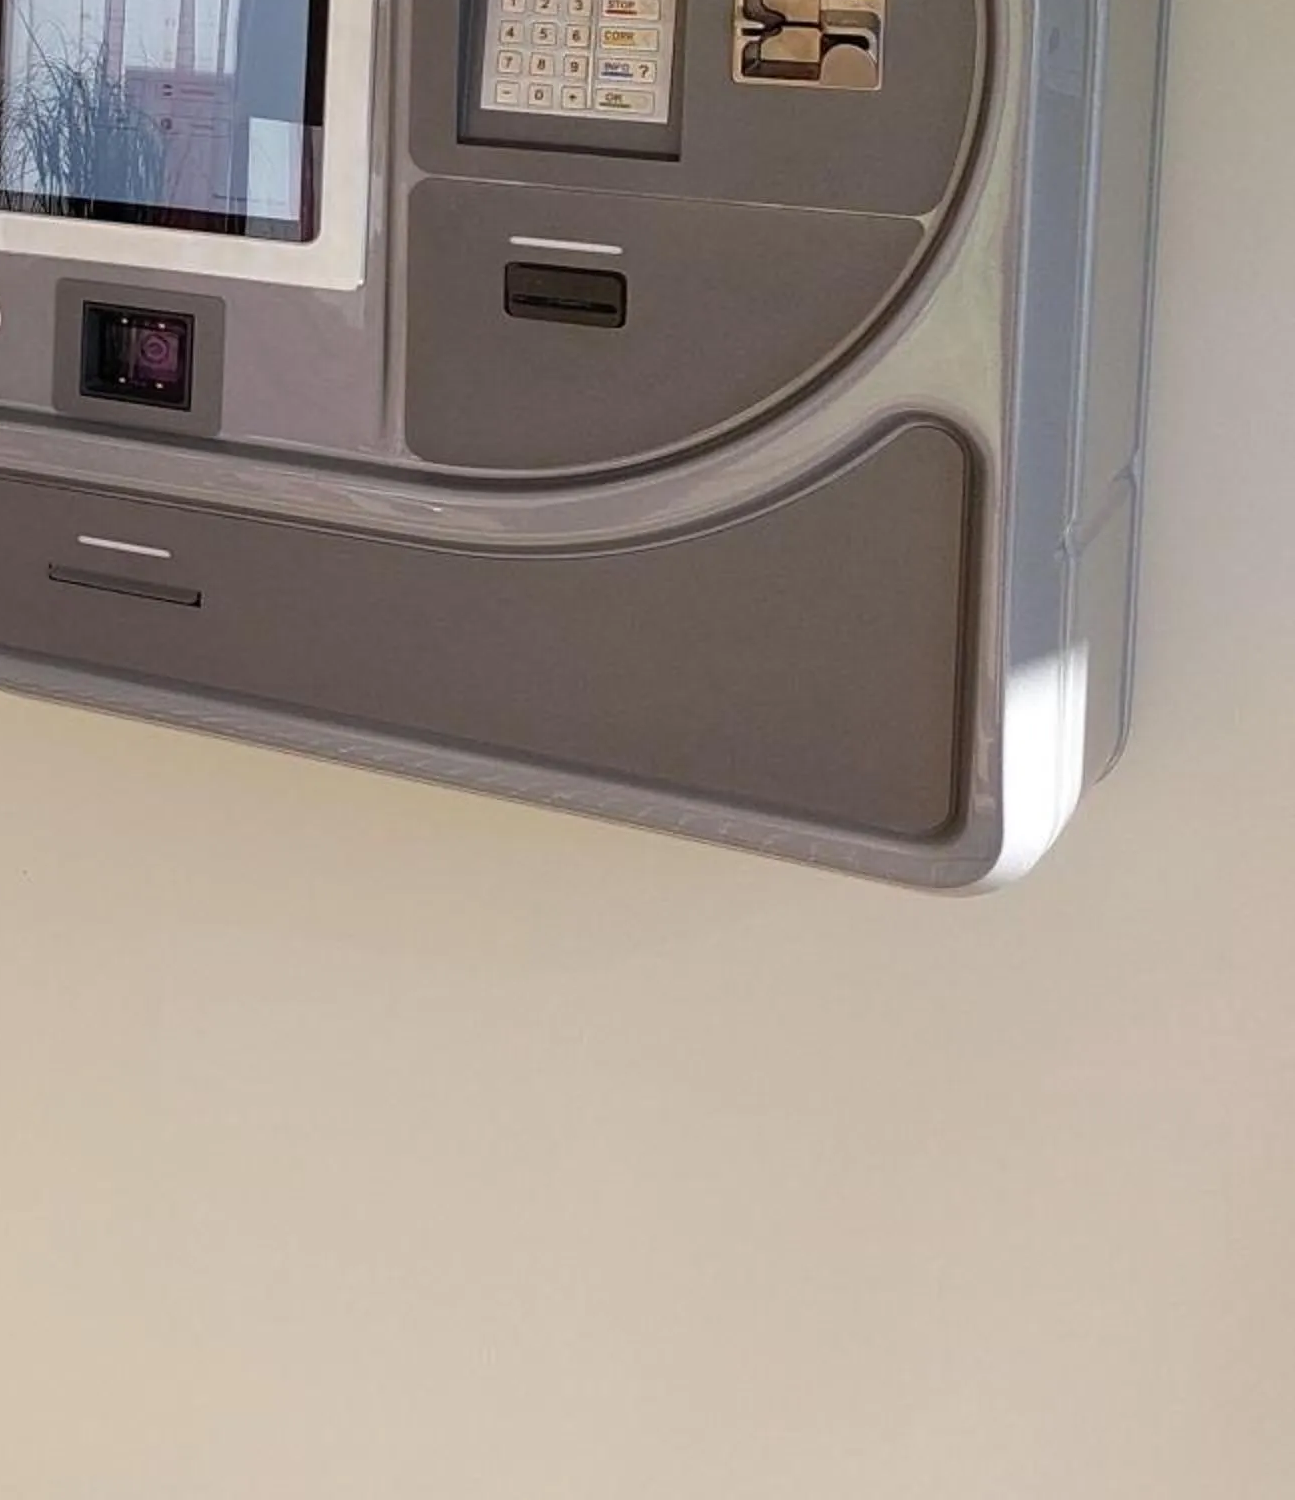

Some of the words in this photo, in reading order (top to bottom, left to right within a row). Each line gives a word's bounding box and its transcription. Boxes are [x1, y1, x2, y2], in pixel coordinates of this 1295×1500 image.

[574, 0, 584, 11] 3
[607, 0, 636, 9] STOP
[505, 26, 515, 38] 4
[538, 28, 548, 40] 5
[572, 30, 581, 41] 6
[504, 57, 513, 68] 7
[537, 59, 546, 71] 8
[570, 61, 580, 73] 9
[638, 64, 649, 79] ?
[534, 89, 544, 101] 0
